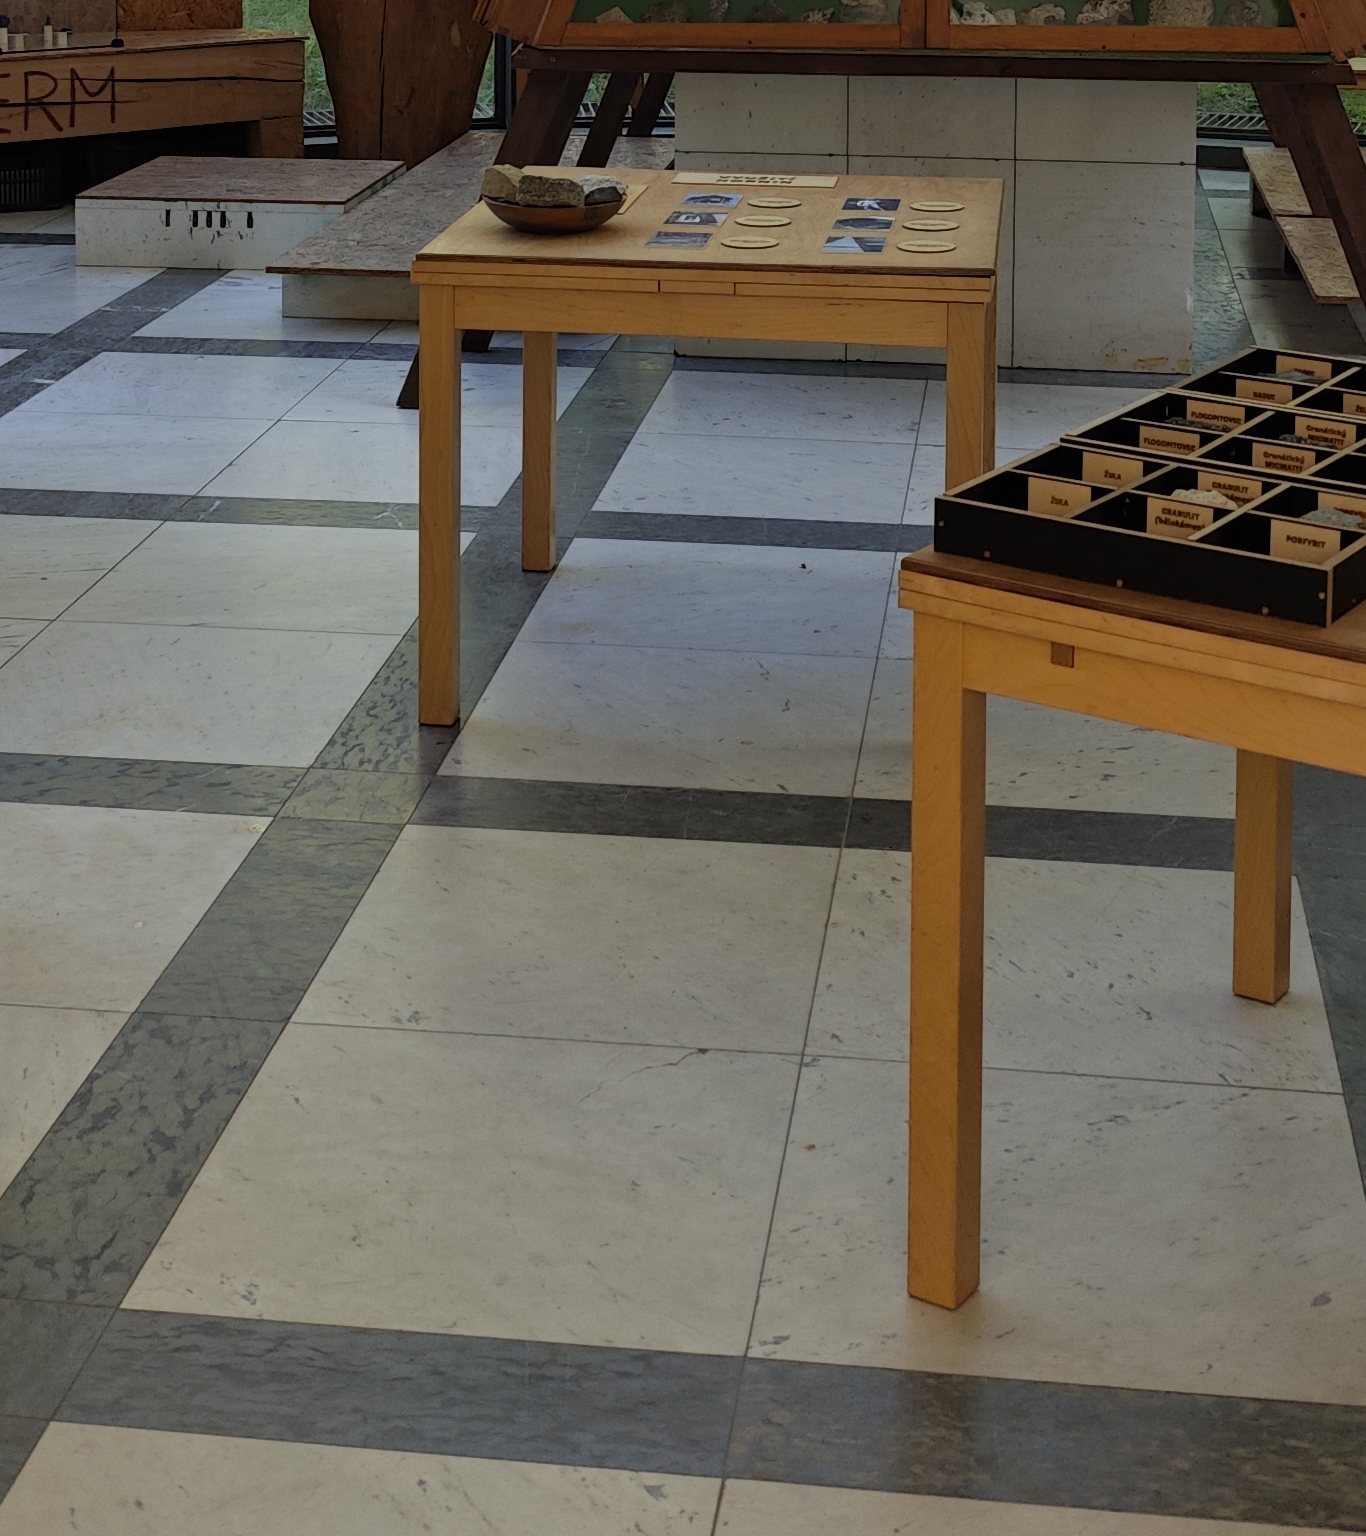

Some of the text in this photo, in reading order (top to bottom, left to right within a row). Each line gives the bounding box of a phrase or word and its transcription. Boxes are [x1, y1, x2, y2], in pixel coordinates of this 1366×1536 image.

[1190, 411, 1242, 425] FLOGOPITOVEC
[1143, 437, 1196, 452] FLOGOPITOVEC
[1103, 469, 1122, 481] ŽULA
[1211, 481, 1249, 494] GRANULIT
[1050, 495, 1069, 507] ŽULA
[1161, 507, 1200, 521] GRANULIT
[1285, 534, 1326, 549] PORFYRIT
